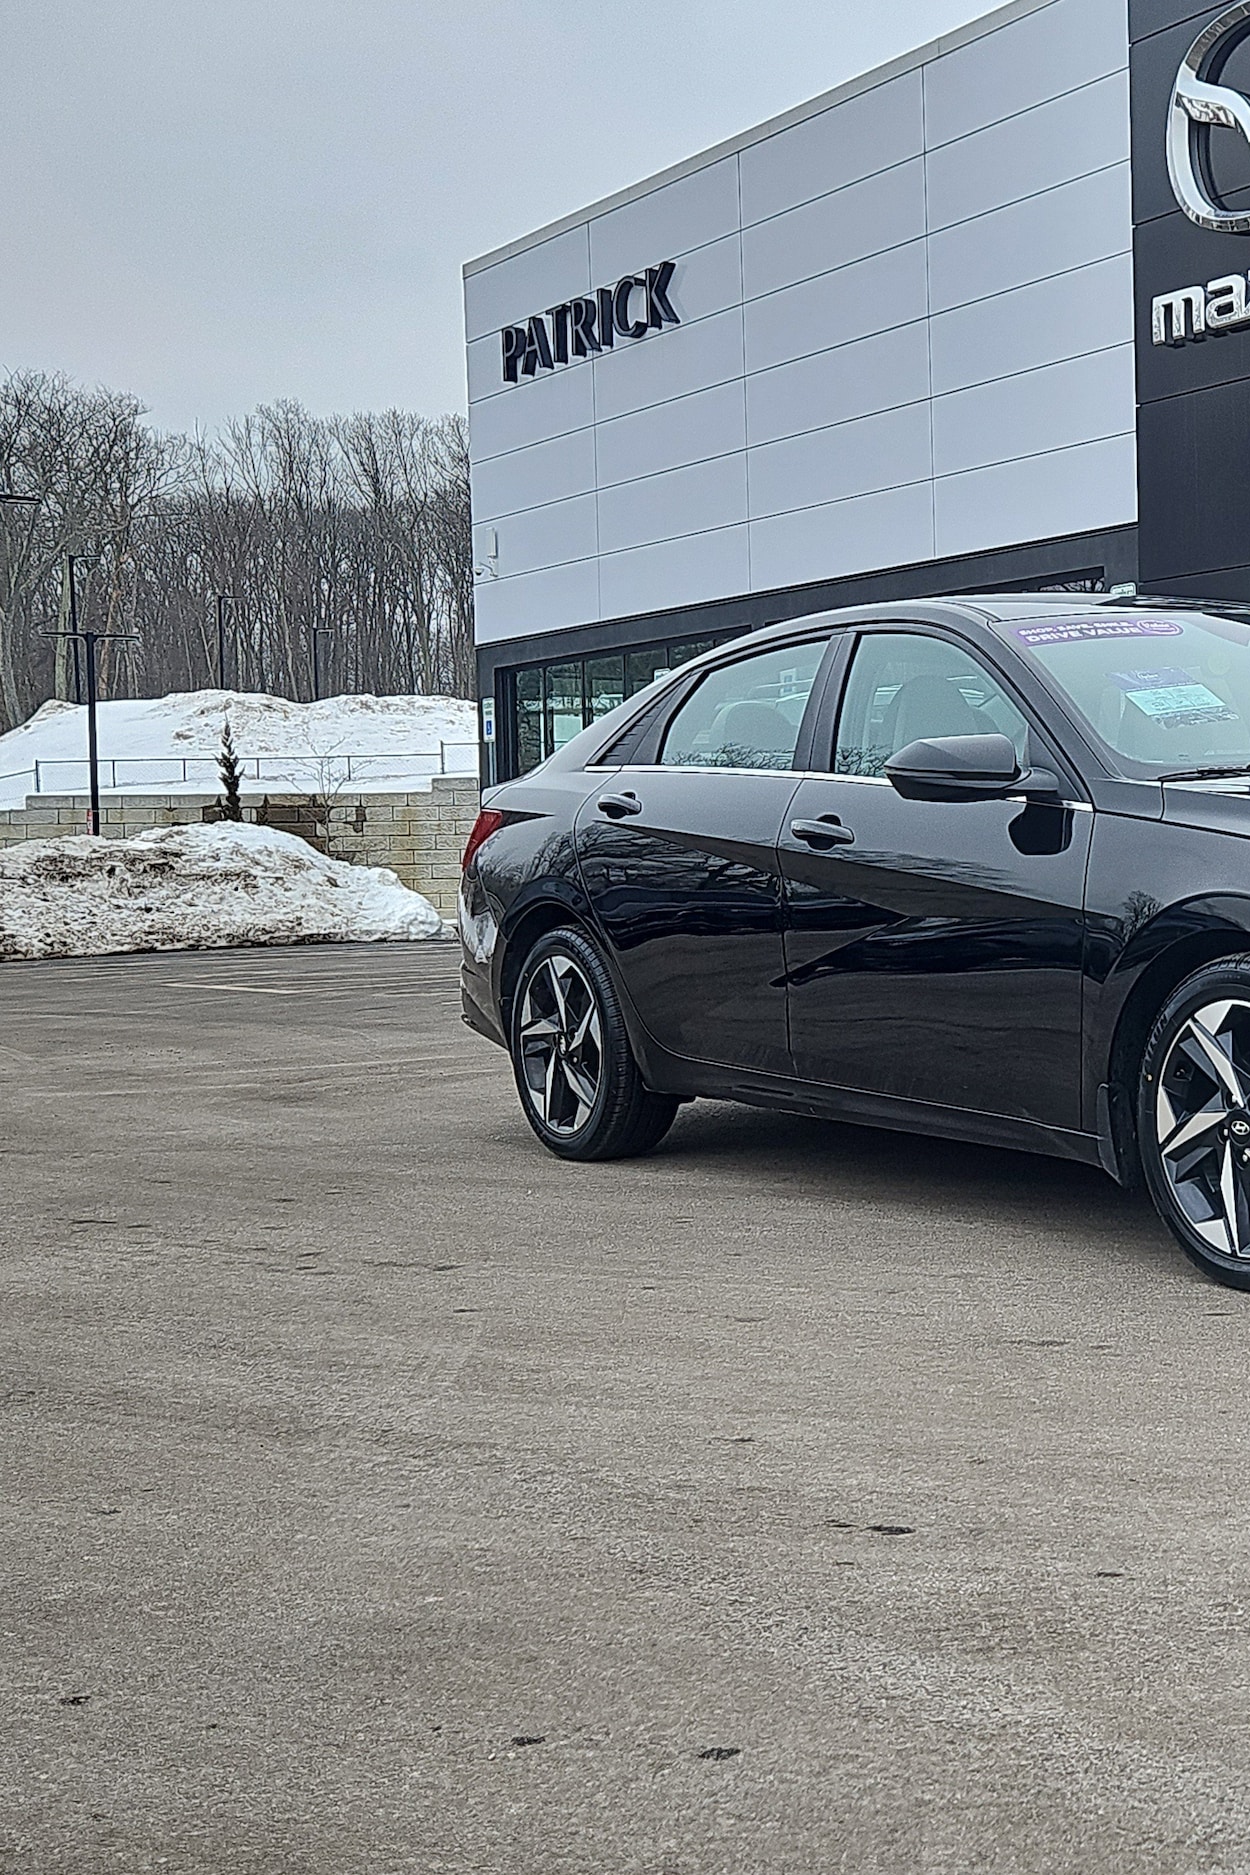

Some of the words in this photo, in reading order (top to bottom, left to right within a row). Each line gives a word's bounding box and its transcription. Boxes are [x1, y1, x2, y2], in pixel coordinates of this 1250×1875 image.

[501, 261, 681, 383] PATRICK
[1025, 631, 1083, 642] DRIVE
[1082, 627, 1143, 636] VALUE
